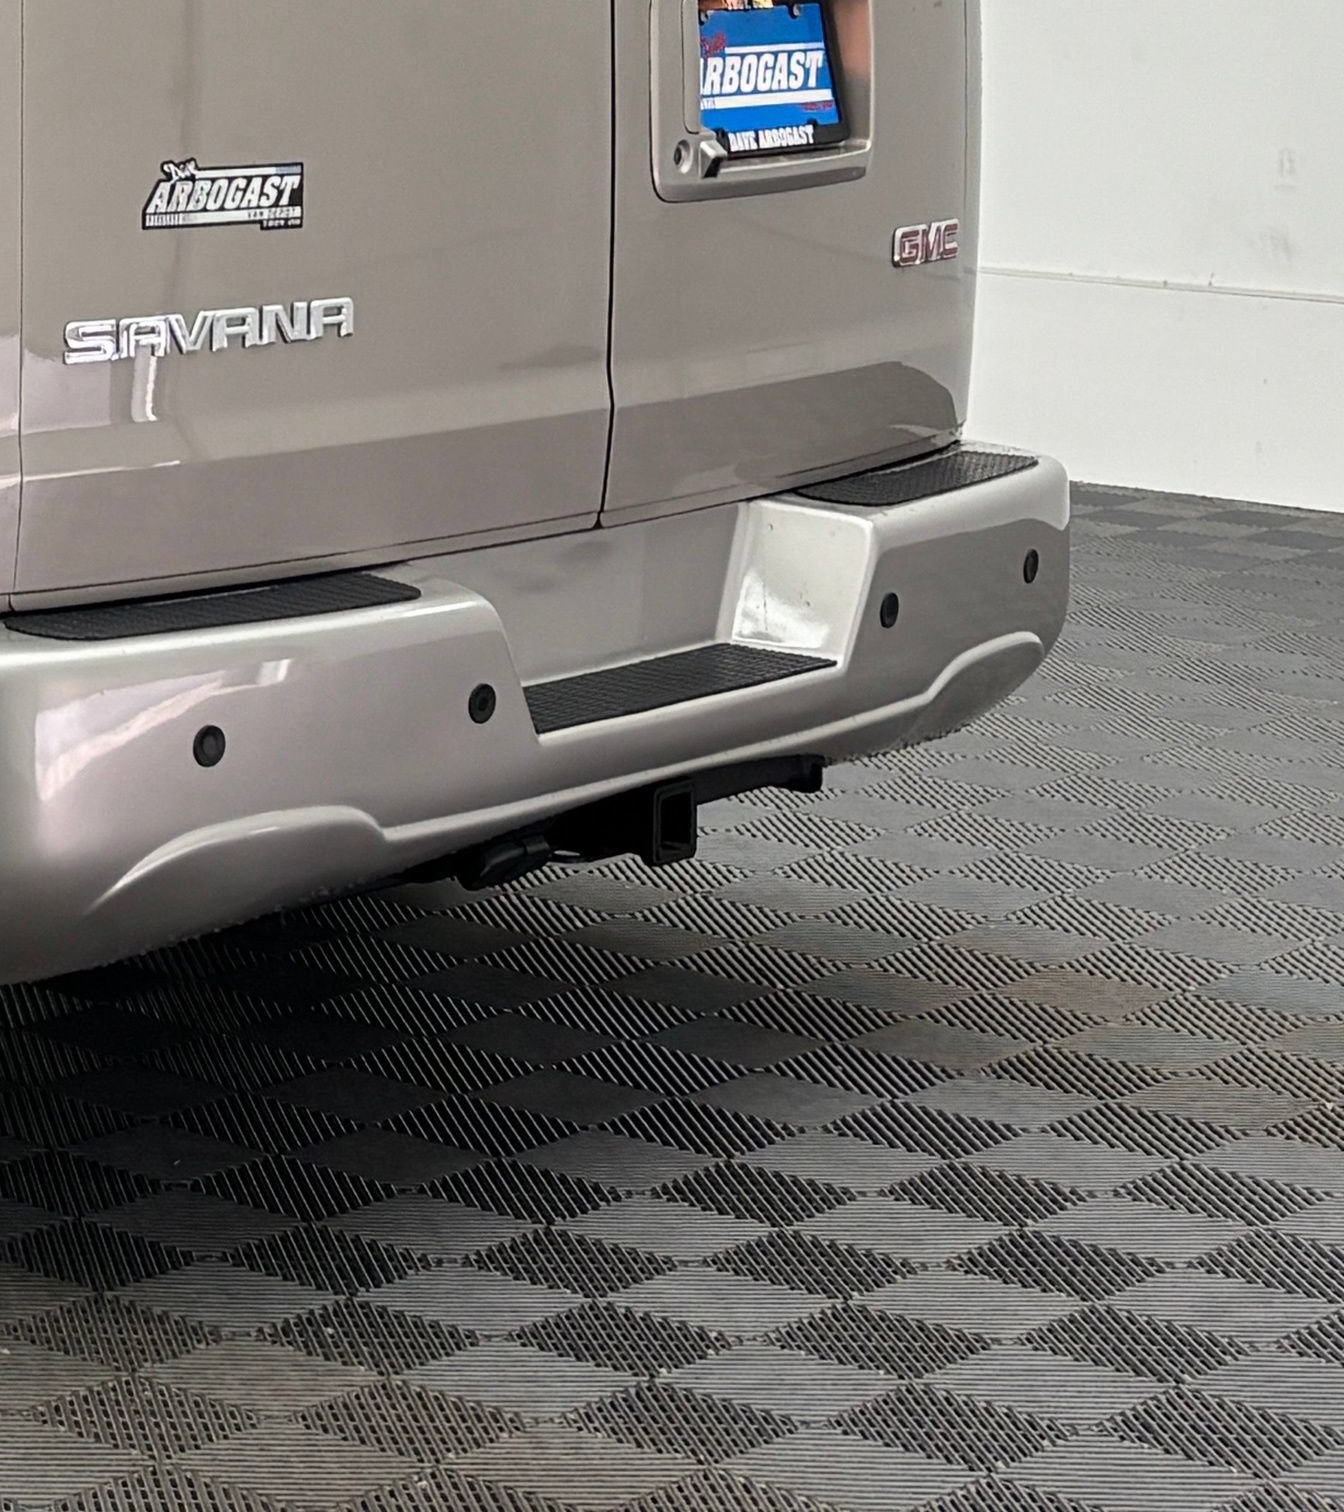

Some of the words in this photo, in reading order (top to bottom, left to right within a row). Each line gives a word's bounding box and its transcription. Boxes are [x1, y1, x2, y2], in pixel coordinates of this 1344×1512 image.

[728, 130, 758, 152] DAVE
[758, 125, 814, 149] ARBOGAST
[146, 175, 301, 213] ARBOGAST
[893, 218, 960, 268] GMC
[63, 297, 354, 365] SAVANA
